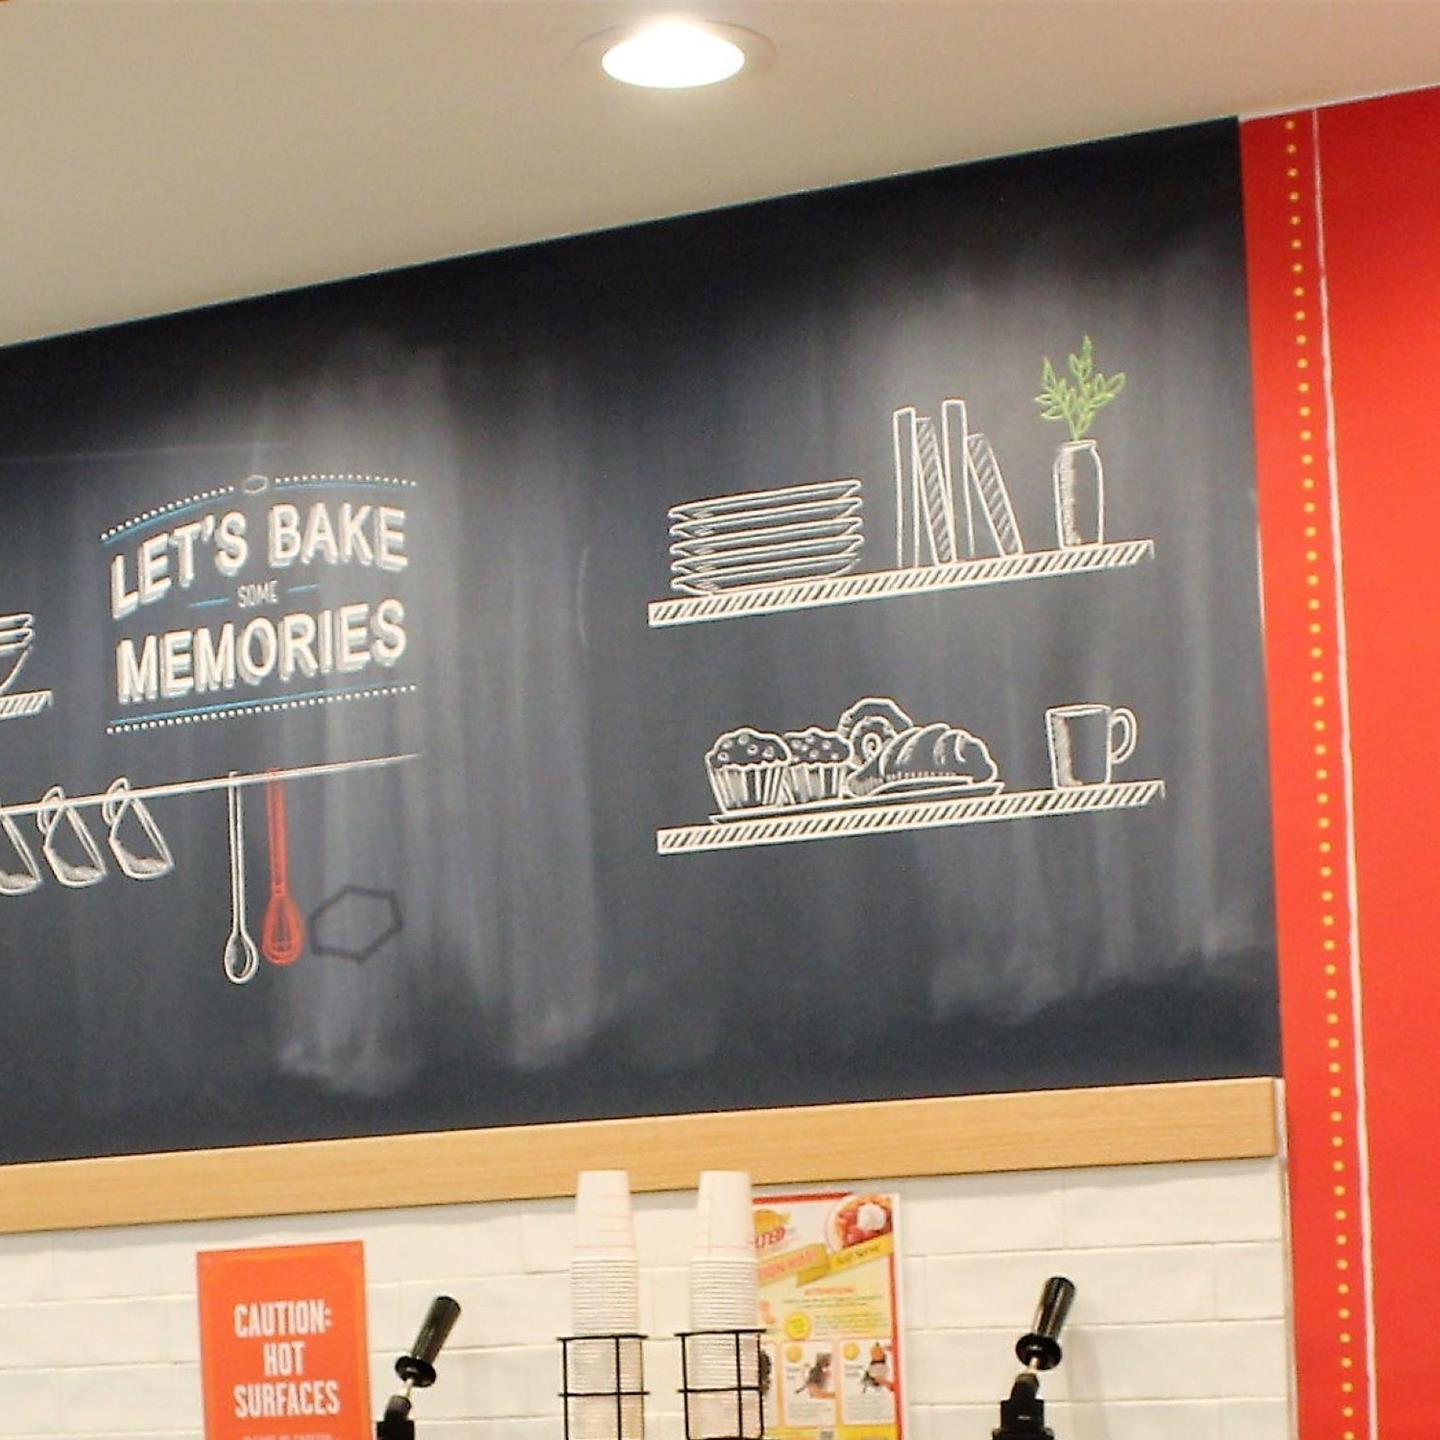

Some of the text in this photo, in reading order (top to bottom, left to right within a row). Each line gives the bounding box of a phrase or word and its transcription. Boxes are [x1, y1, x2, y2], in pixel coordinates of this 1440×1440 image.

[110, 502, 409, 621] LET'S BAKE
[237, 580, 279, 608] SOME
[115, 599, 407, 704] MEMORIES
[234, 1299, 333, 1338] CAUTION:
[263, 1341, 305, 1377] HOT
[234, 1380, 341, 1418] SURFACES
